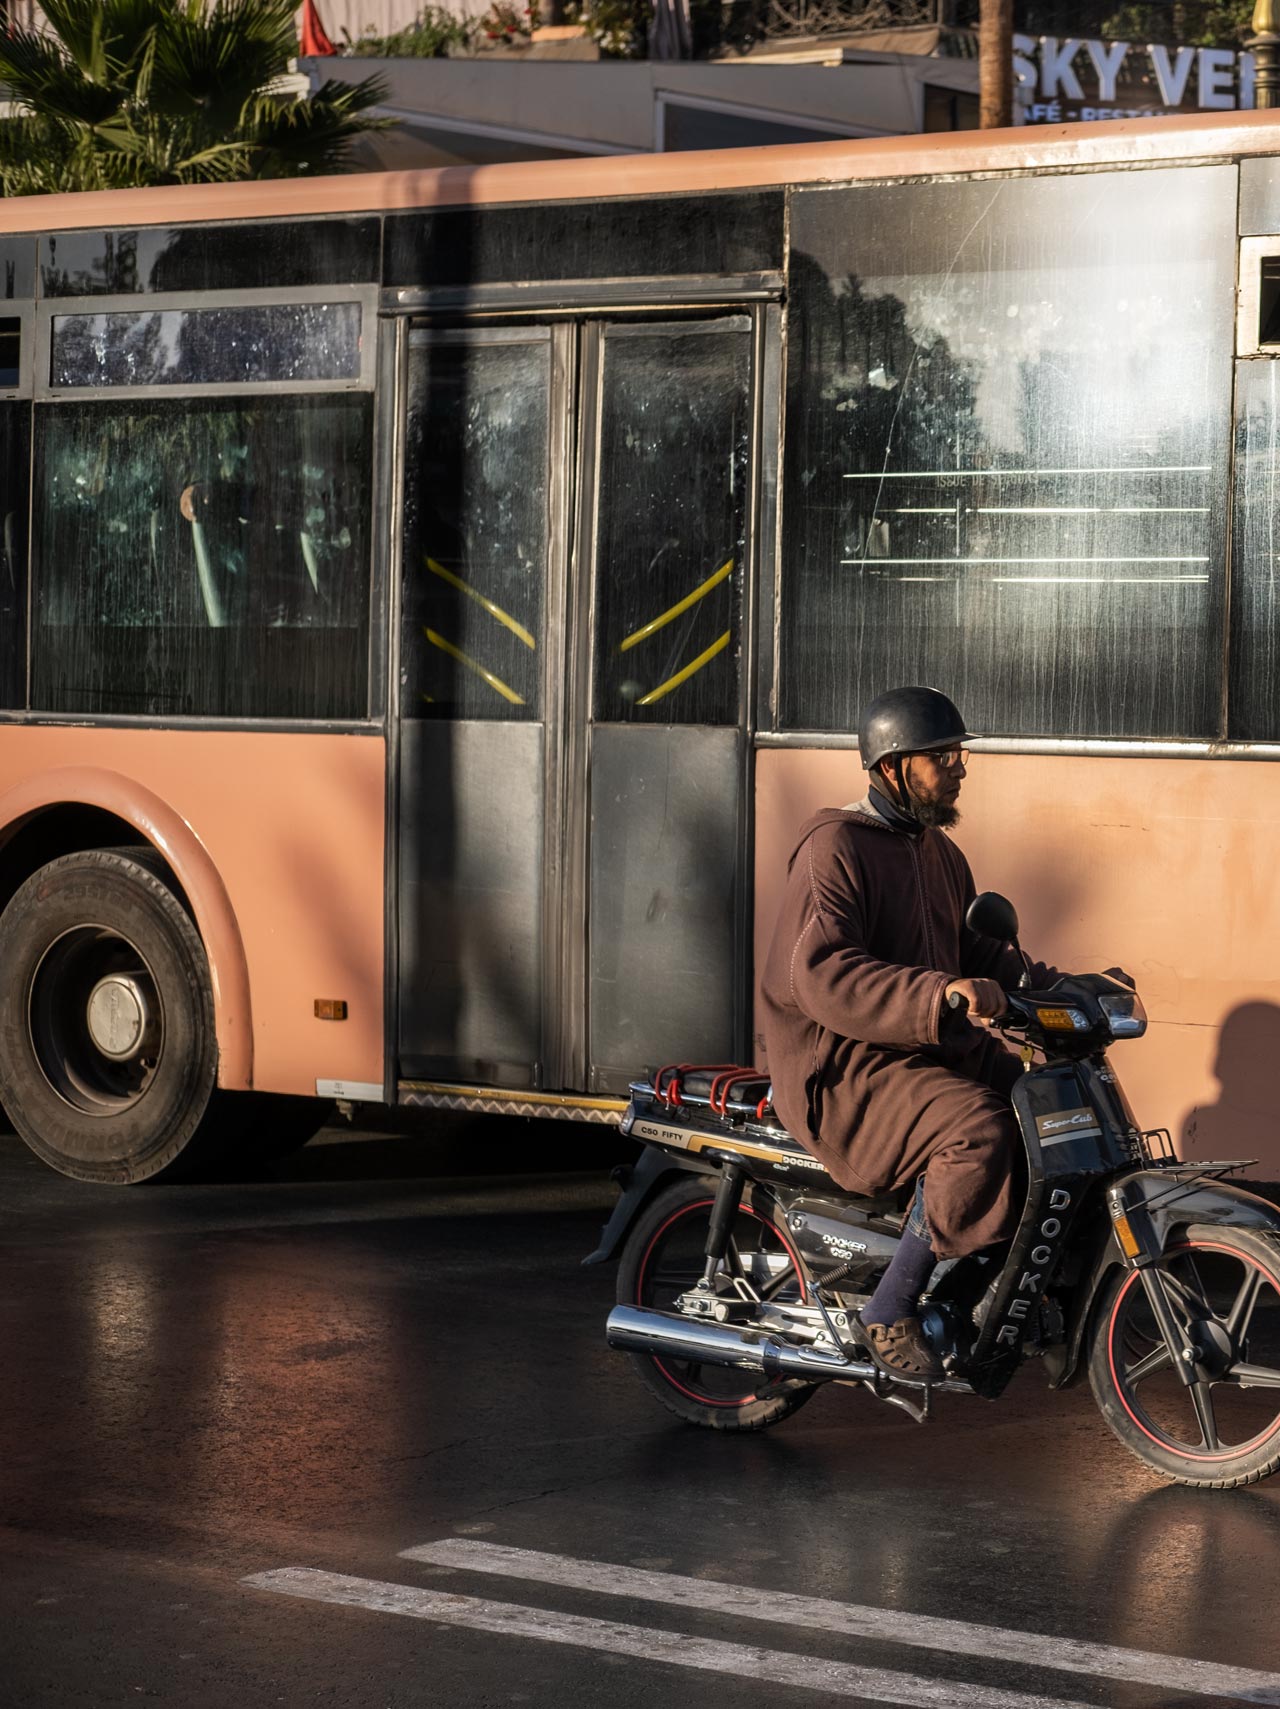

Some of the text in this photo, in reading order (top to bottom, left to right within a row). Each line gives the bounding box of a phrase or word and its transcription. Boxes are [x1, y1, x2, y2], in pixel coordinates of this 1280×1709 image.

[1012, 34, 1130, 101] SKY
[1024, 100, 1062, 121] AFÉ
[641, 1126, 684, 1142] C50 FIFTY
[782, 1155, 825, 1171] DOCKER
[822, 1234, 868, 1254] DOCKER
[996, 1188, 1072, 1346] DOCKER
